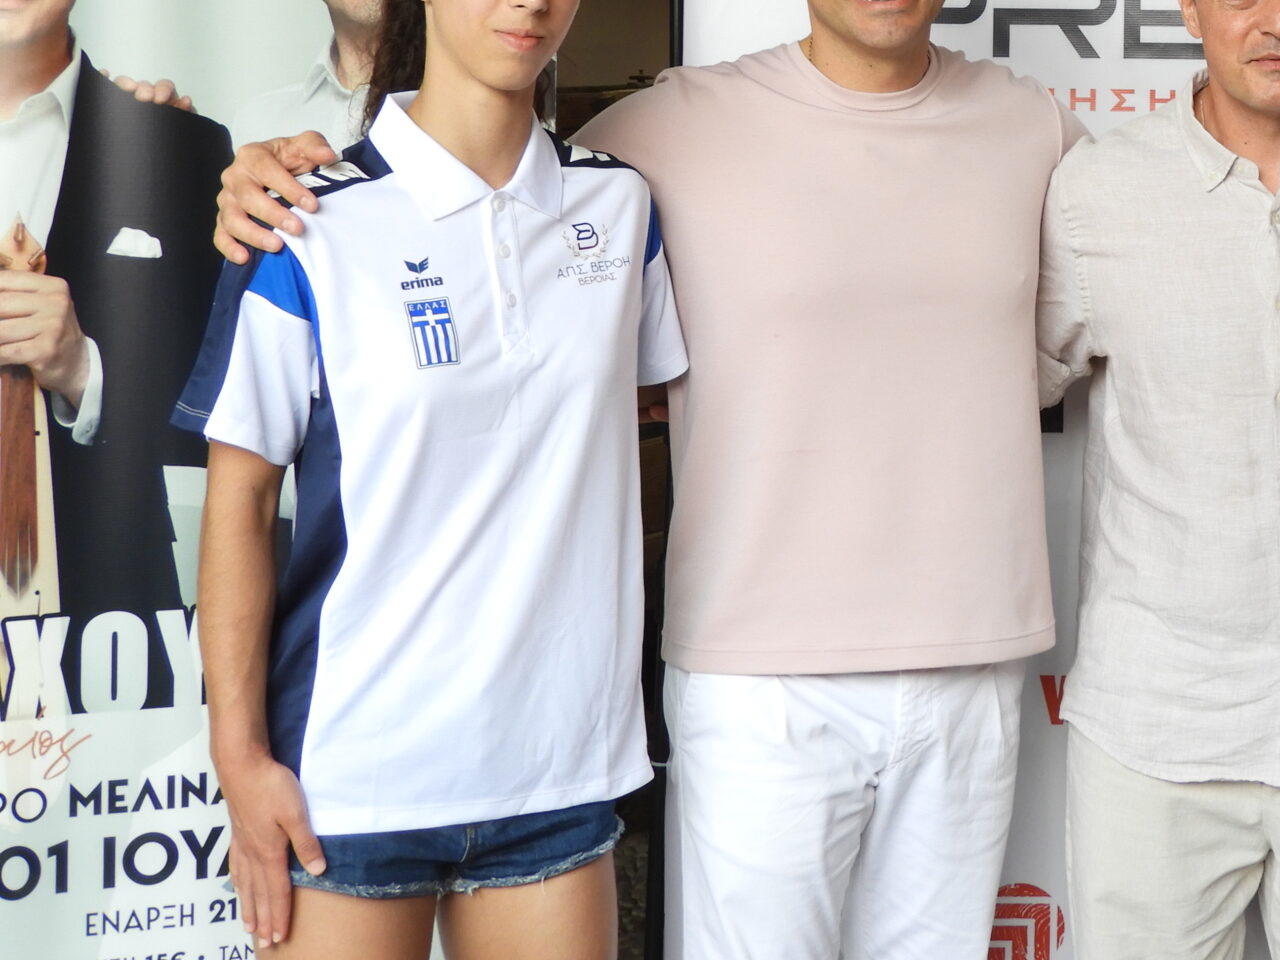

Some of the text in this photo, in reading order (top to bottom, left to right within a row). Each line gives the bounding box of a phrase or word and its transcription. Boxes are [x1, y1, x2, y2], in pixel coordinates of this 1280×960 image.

[590, 255, 631, 273] ΒΕΡΟΗ
[400, 275, 444, 291] erima
[408, 300, 447, 312] ΕΛΛΑΣ
[85, 902, 195, 937] ΕΝΑΡΞΗ
